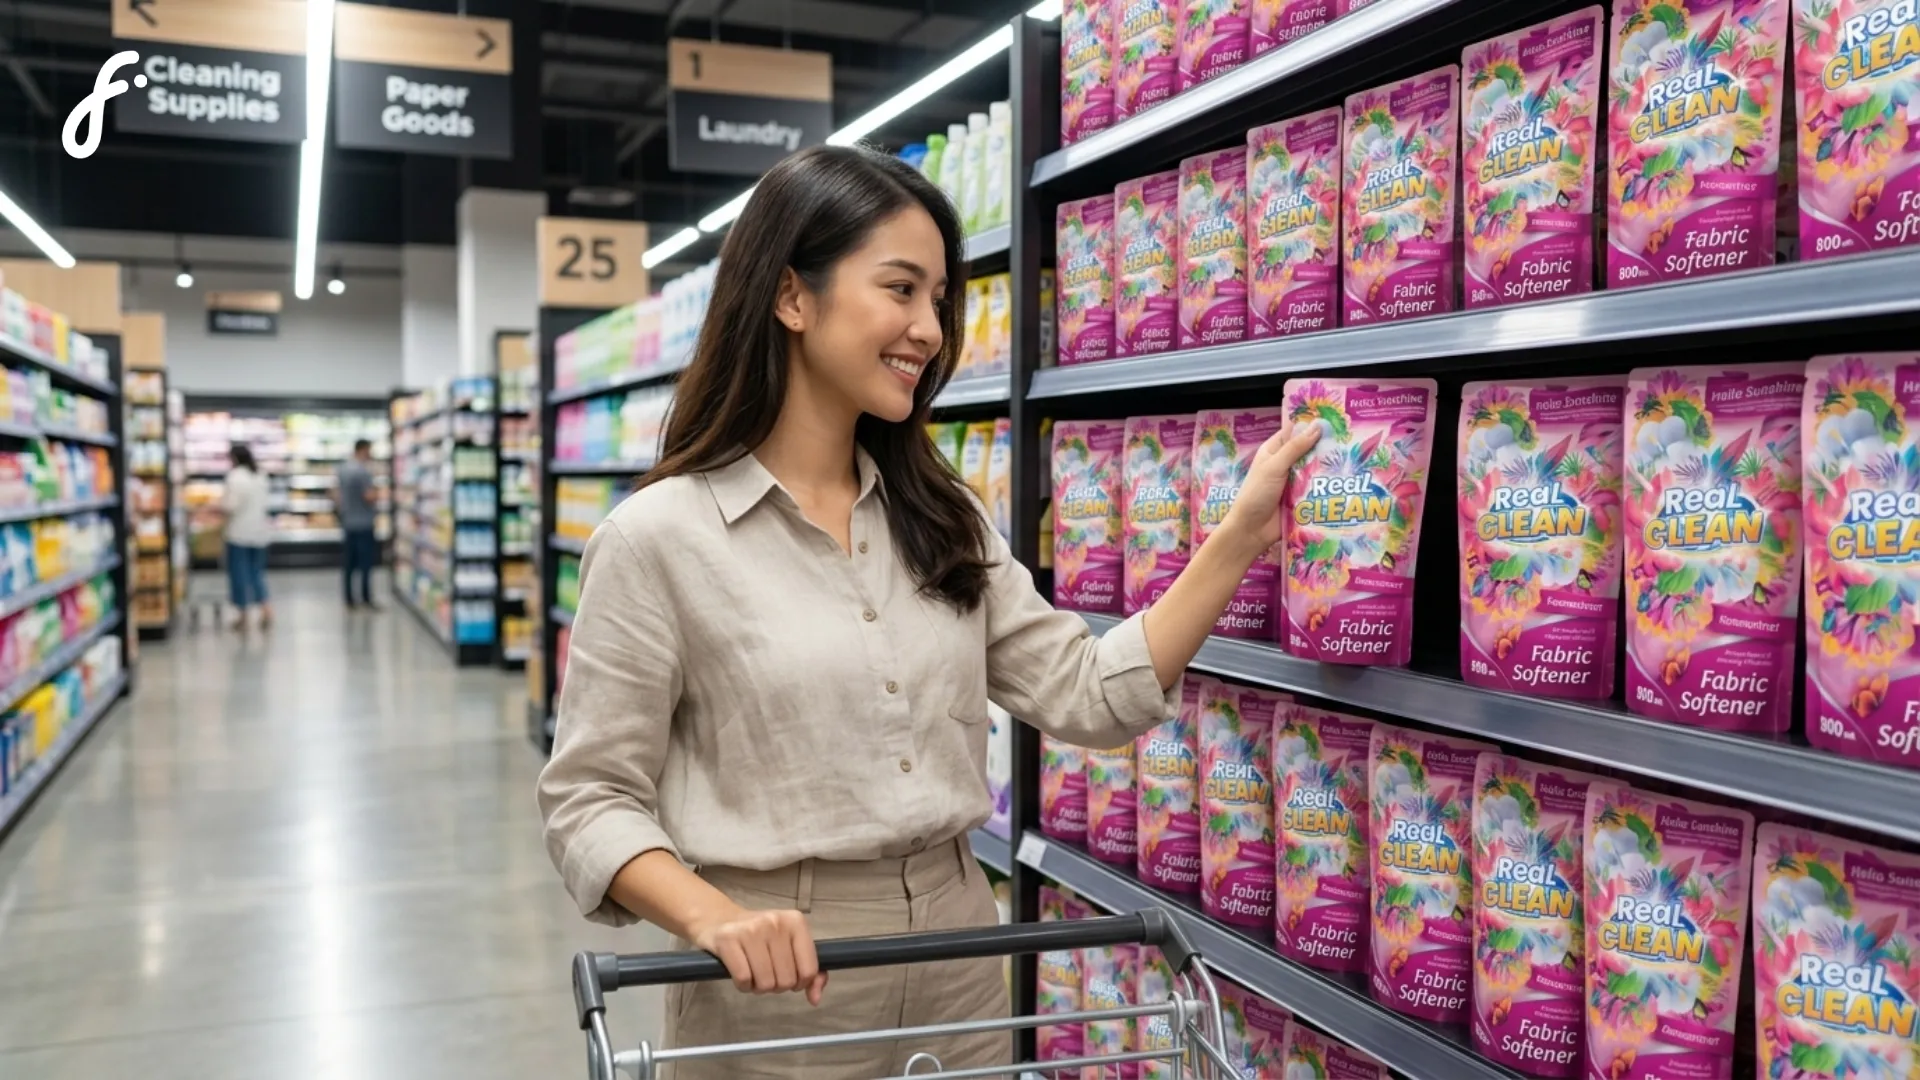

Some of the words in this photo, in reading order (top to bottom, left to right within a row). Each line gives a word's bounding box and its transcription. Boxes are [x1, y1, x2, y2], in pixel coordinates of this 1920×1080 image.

[144, 54, 281, 98] Cleaning
[690, 52, 702, 79] 1
[386, 75, 470, 110] Paper
[1648, 62, 1719, 106] Real
[147, 86, 280, 123] Supplies
[1629, 86, 1741, 144] CLEAN
[381, 104, 475, 138] Goods
[698, 115, 802, 151] Laundry
[1685, 225, 1751, 249] Fabric
[557, 236, 618, 280] 25
[1664, 248, 1749, 275] Softener
[1503, 275, 1572, 299] Softener
[1379, 298, 1436, 318] Softener
[1293, 496, 1393, 525] CLEAN
[1495, 482, 1565, 511] Real
[1664, 481, 1743, 516] Real
[1477, 504, 1587, 541] CLEAN
[1643, 511, 1765, 550] CLEAN
[1339, 618, 1394, 636] Fabric
[1321, 635, 1392, 656] Softener
[1531, 645, 1593, 665] Fabric
[1512, 664, 1591, 687] Softener
[1700, 670, 1769, 694] Fabric
[1679, 690, 1767, 717] Softener
[1393, 819, 1445, 845] Real
[1379, 840, 1462, 876] CLEAN
[1497, 857, 1557, 886] Real
[1481, 880, 1575, 920] CLEAN
[1617, 894, 1685, 929] Real
[1310, 921, 1358, 944] Fabric
[1598, 920, 1705, 964] CLEAN
[1296, 936, 1356, 960] Softener
[1414, 968, 1467, 993] Fabric
[1801, 953, 1889, 997] Real
[1398, 983, 1466, 1009] Softener
[1776, 982, 1917, 1039] CLEAN
[1519, 1018, 1578, 1045] Fabric
[1501, 1033, 1578, 1065] Softener
